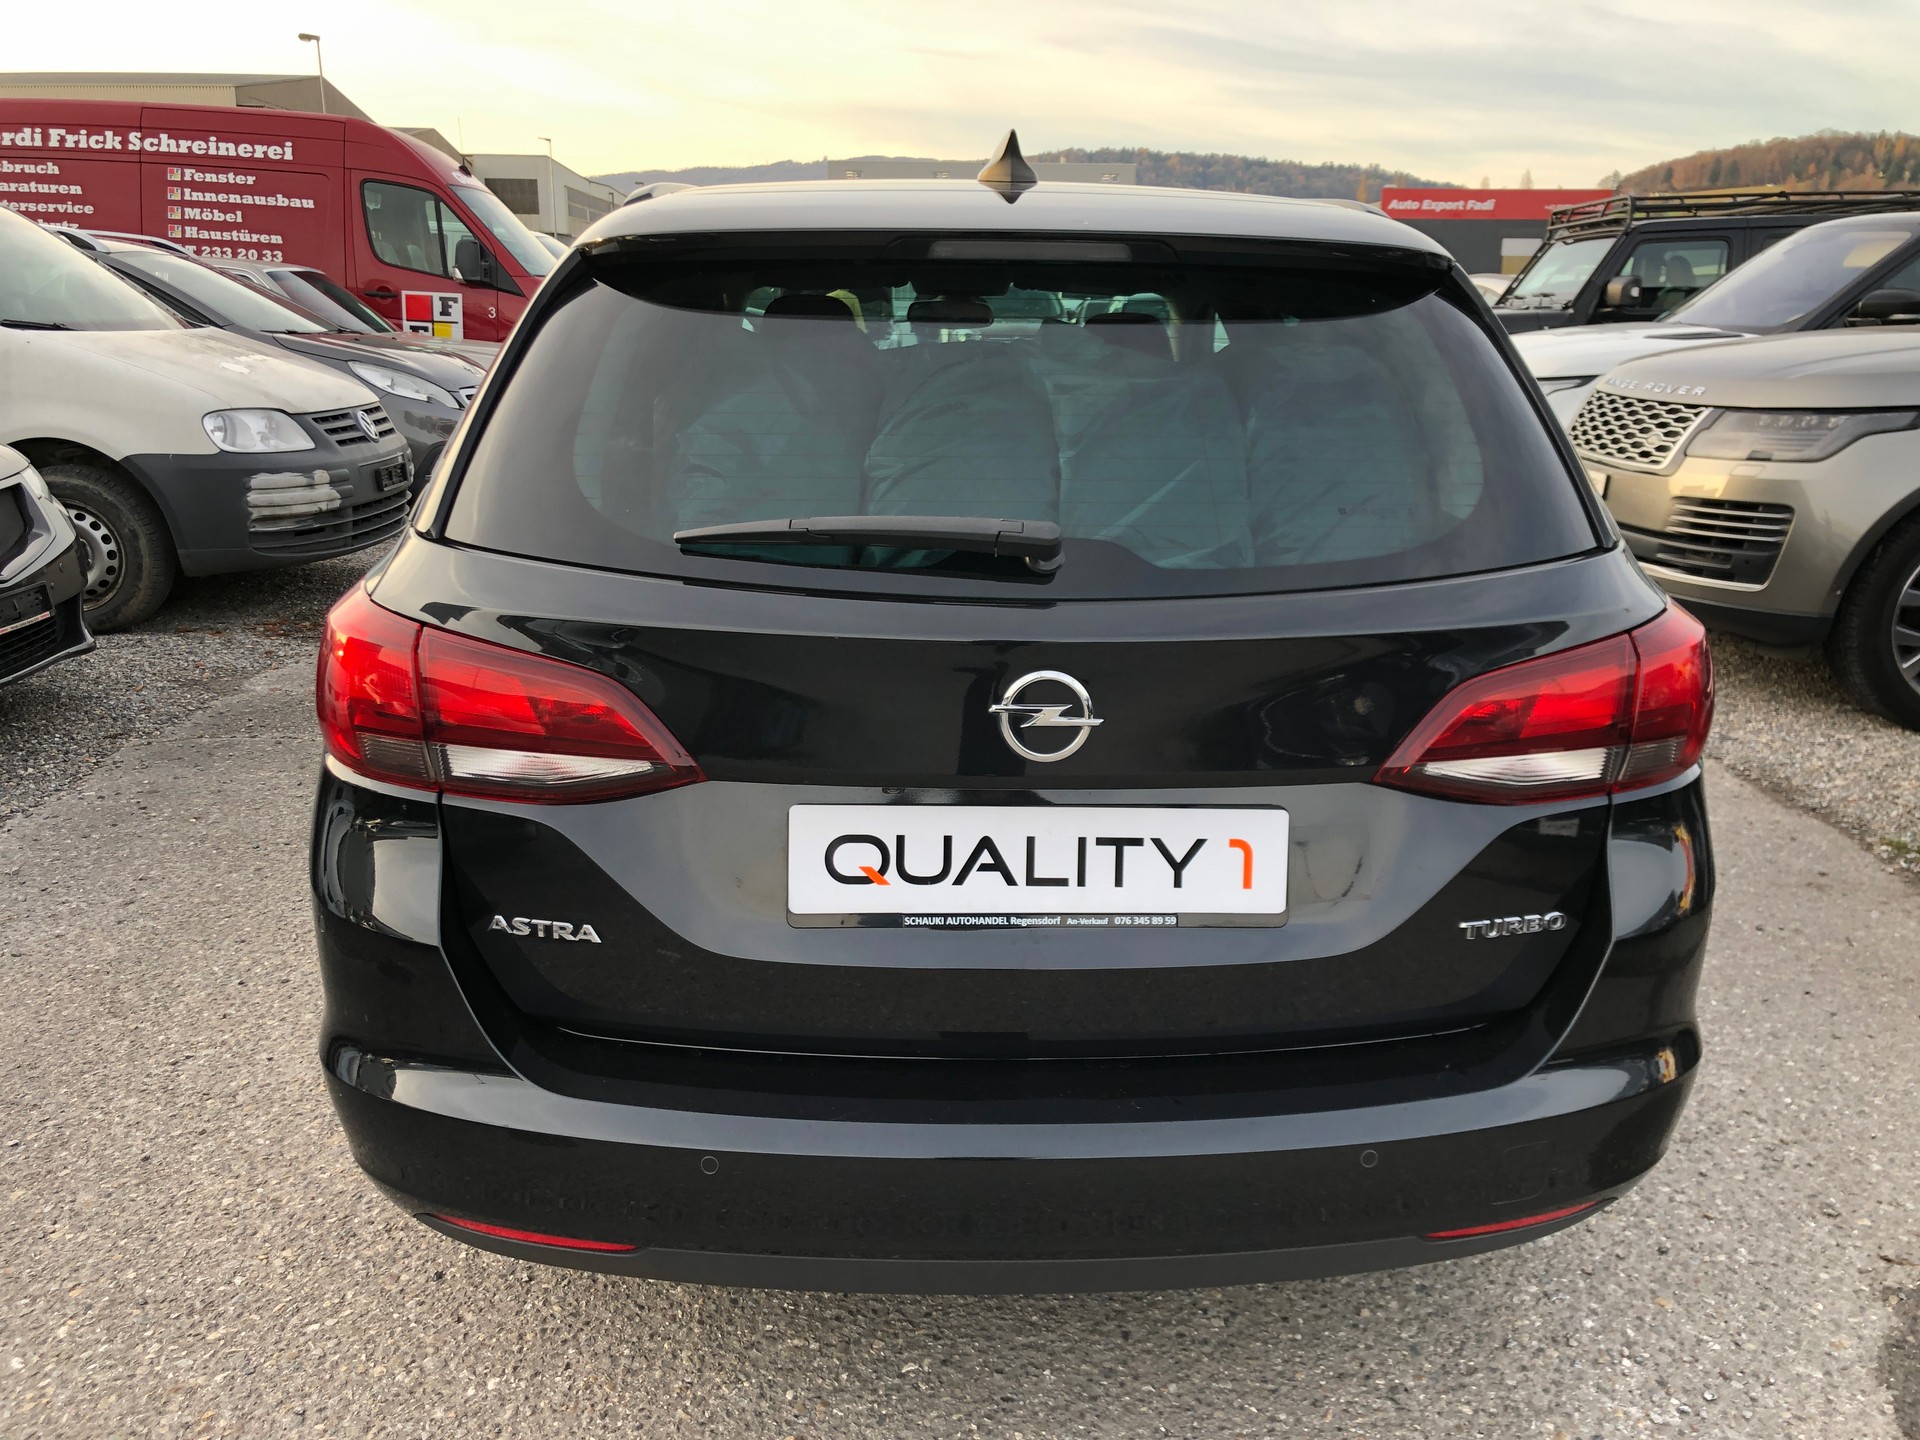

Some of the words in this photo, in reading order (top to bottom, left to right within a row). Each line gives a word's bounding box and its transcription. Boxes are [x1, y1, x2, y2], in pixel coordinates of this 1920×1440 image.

[0, 127, 42, 147] rdi
[48, 128, 122, 150] Frick
[128, 131, 293, 161] Schreinerei
[0, 160, 60, 174] bruch
[183, 168, 256, 185] Fenster
[183, 188, 315, 209] Innenausbau
[1388, 199, 1419, 210] Auto
[1421, 199, 1465, 212] Export
[1466, 199, 1496, 211] Fadi
[184, 207, 243, 223] Möbel
[184, 226, 283, 244] Haustüren
[201, 246, 232, 259] 233
[237, 248, 258, 260] 20
[262, 250, 283, 262] 33
[488, 306, 497, 319] 3
[1643, 382, 1706, 396] ROVER
[824, 833, 1208, 889] QUALITY
[1228, 838, 1254, 890] 1
[487, 914, 602, 943] ASTRA
[904, 916, 945, 926] SCHAUKI
[946, 916, 1009, 926] AUTOHANDEL
[1010, 916, 1061, 927] Regensdorf
[1066, 917, 1109, 926] An-Verkauf
[1114, 916, 1132, 925] 076
[1133, 916, 1150, 925] 345
[1165, 916, 1177, 925] 59
[1458, 911, 1567, 940] TURBO
